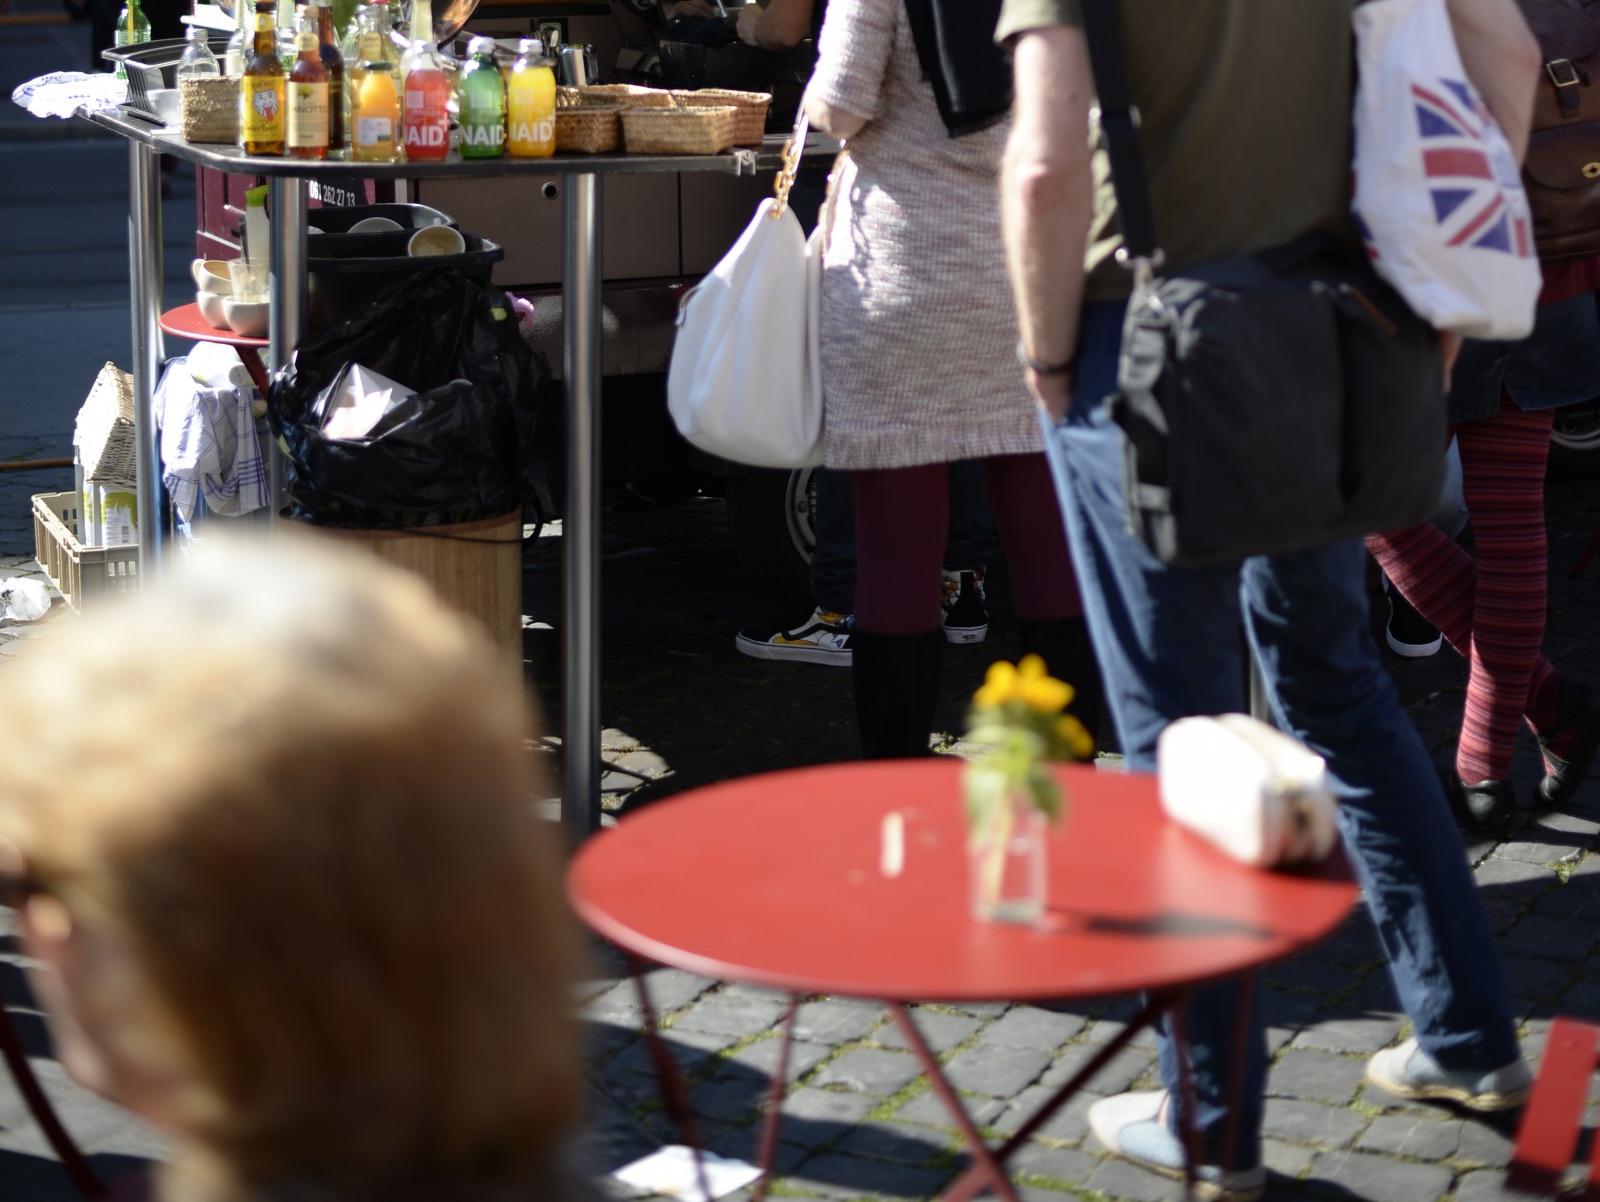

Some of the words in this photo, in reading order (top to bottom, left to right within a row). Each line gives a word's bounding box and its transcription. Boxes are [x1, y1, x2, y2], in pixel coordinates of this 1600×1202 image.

[291, 105, 328, 114] HINOTTO
[309, 180, 322, 201] 061
[322, 185, 336, 205] 262
[336, 189, 345, 207] 27
[346, 191, 356, 207] 13
